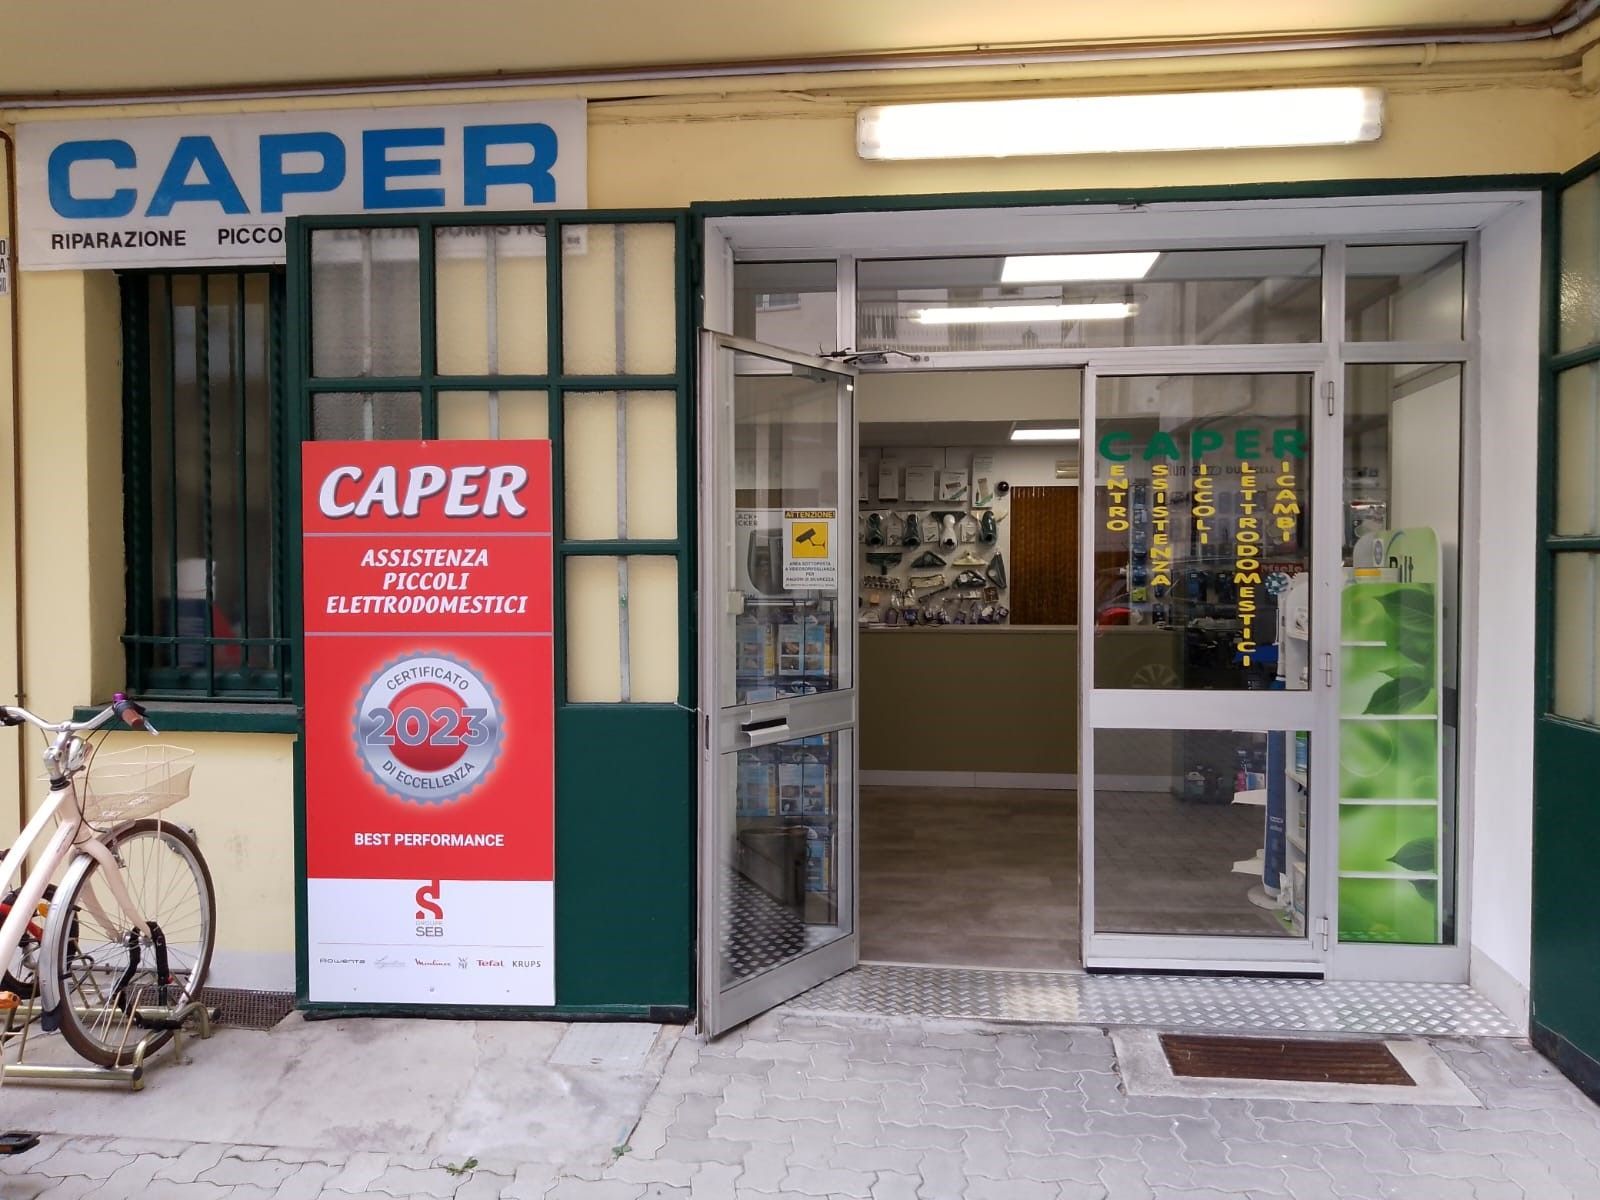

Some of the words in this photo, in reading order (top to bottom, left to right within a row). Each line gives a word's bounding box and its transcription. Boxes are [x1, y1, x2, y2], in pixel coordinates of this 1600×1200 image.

[47, 122, 559, 219] CAPER
[52, 229, 187, 250] RIPARAZIONE
[218, 227, 286, 246] PICCO
[1099, 431, 1306, 460] CAPER
[319, 464, 527, 519] CAPER
[1106, 464, 1129, 532] ENTRO
[1191, 464, 1217, 544] ICCOLI
[1272, 461, 1301, 543] ICAMBI
[1150, 464, 1172, 586] SSISTENZA
[361, 548, 489, 567] ASSISTENZA
[1233, 461, 1262, 667] LETTRODOMESTICI
[383, 572, 470, 591] PICCOLI
[326, 595, 528, 614] ELETTRODOMESTICI
[386, 666, 469, 691] CERTIFICATO
[365, 707, 490, 746] 2023
[382, 760, 398, 776] DI
[396, 761, 475, 789] ECCELLENZA
[354, 833, 391, 846] BEST
[394, 833, 505, 847] PERFORMANCE
[415, 927, 443, 937] SEB
[476, 958, 504, 967] Tefal
[512, 960, 542, 968] KRUPS
